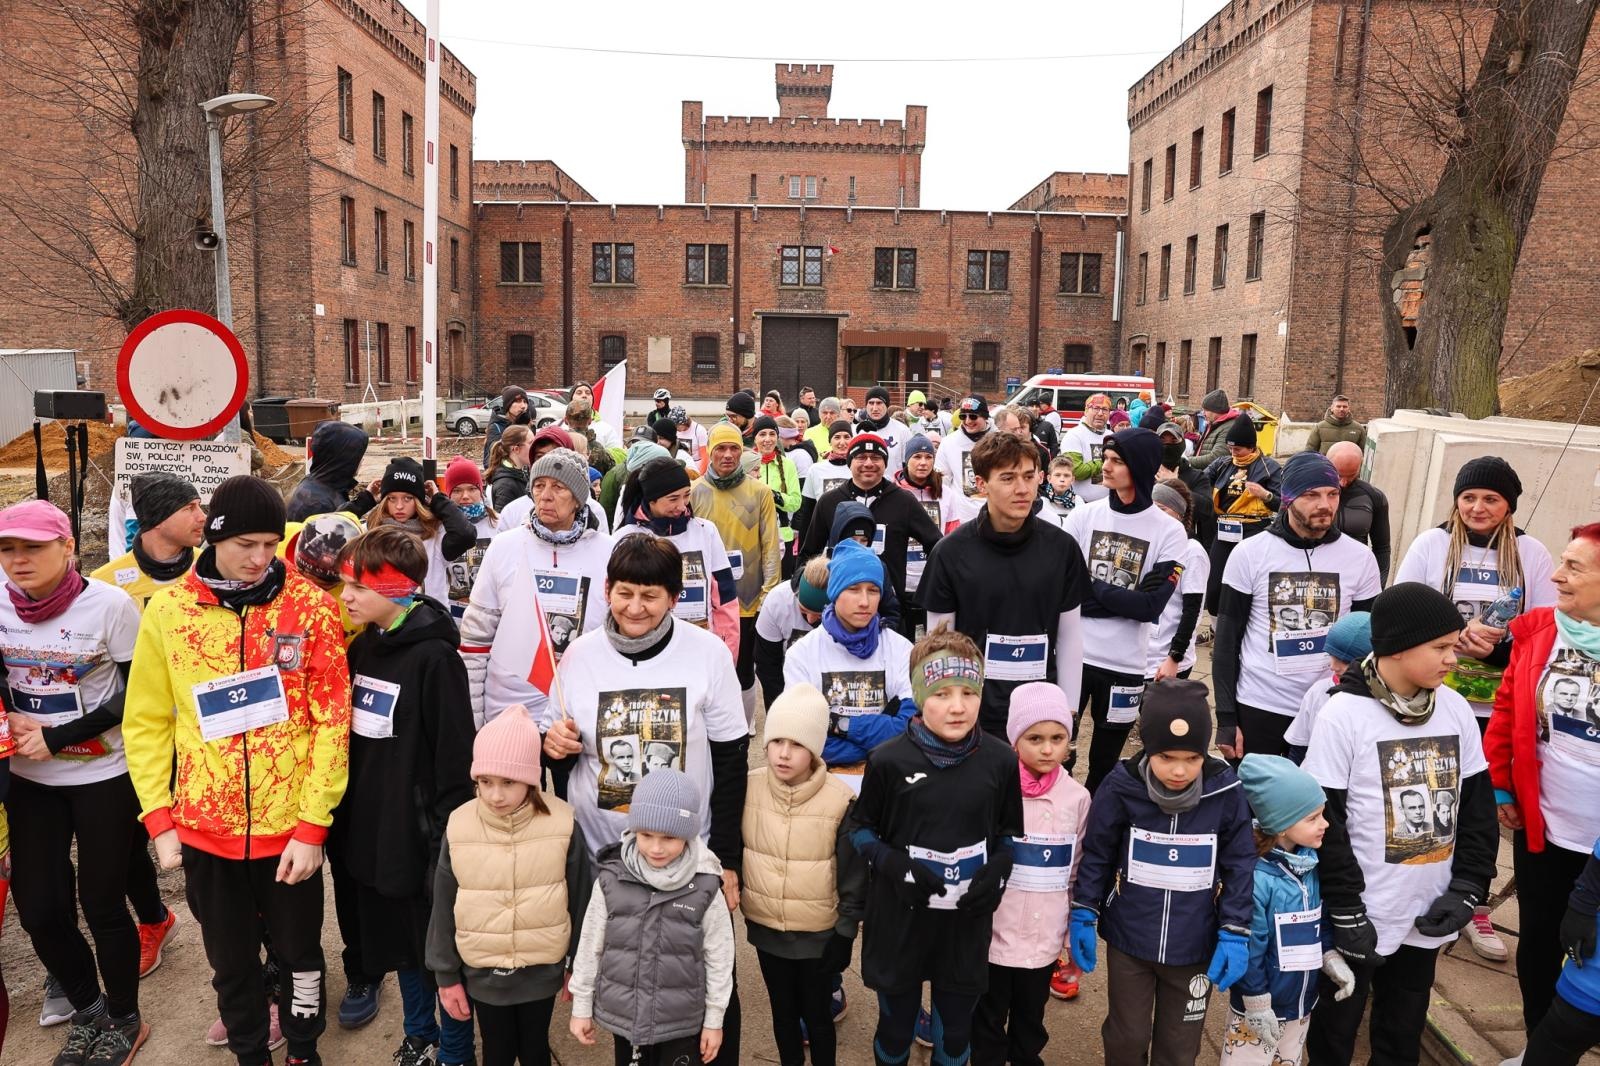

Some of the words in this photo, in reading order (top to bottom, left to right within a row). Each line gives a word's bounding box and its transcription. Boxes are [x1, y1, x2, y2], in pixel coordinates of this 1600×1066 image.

[124, 441, 140, 449] NIE
[143, 441, 184, 451] DOTYCZY
[189, 442, 238, 453] POJAZDÓW
[125, 462, 192, 472] DOSTAWCZYCH
[203, 465, 229, 475] ORAZ
[393, 471, 417, 483] SWAG
[210, 515, 225, 531] 4F
[1477, 571, 1491, 581] 19
[538, 578, 554, 590] 20
[1295, 587, 1337, 597] WILCZYM
[1298, 640, 1315, 651] 30
[1011, 647, 1026, 658] 47
[228, 687, 248, 704] 32
[361, 692, 375, 707] 44
[1129, 695, 1139, 705] 90
[29, 697, 42, 710] 17
[629, 708, 681, 722] WILCZYM
[1413, 756, 1458, 772] WILCZYM
[1043, 849, 1052, 862] 9
[1168, 848, 1179, 862] 8
